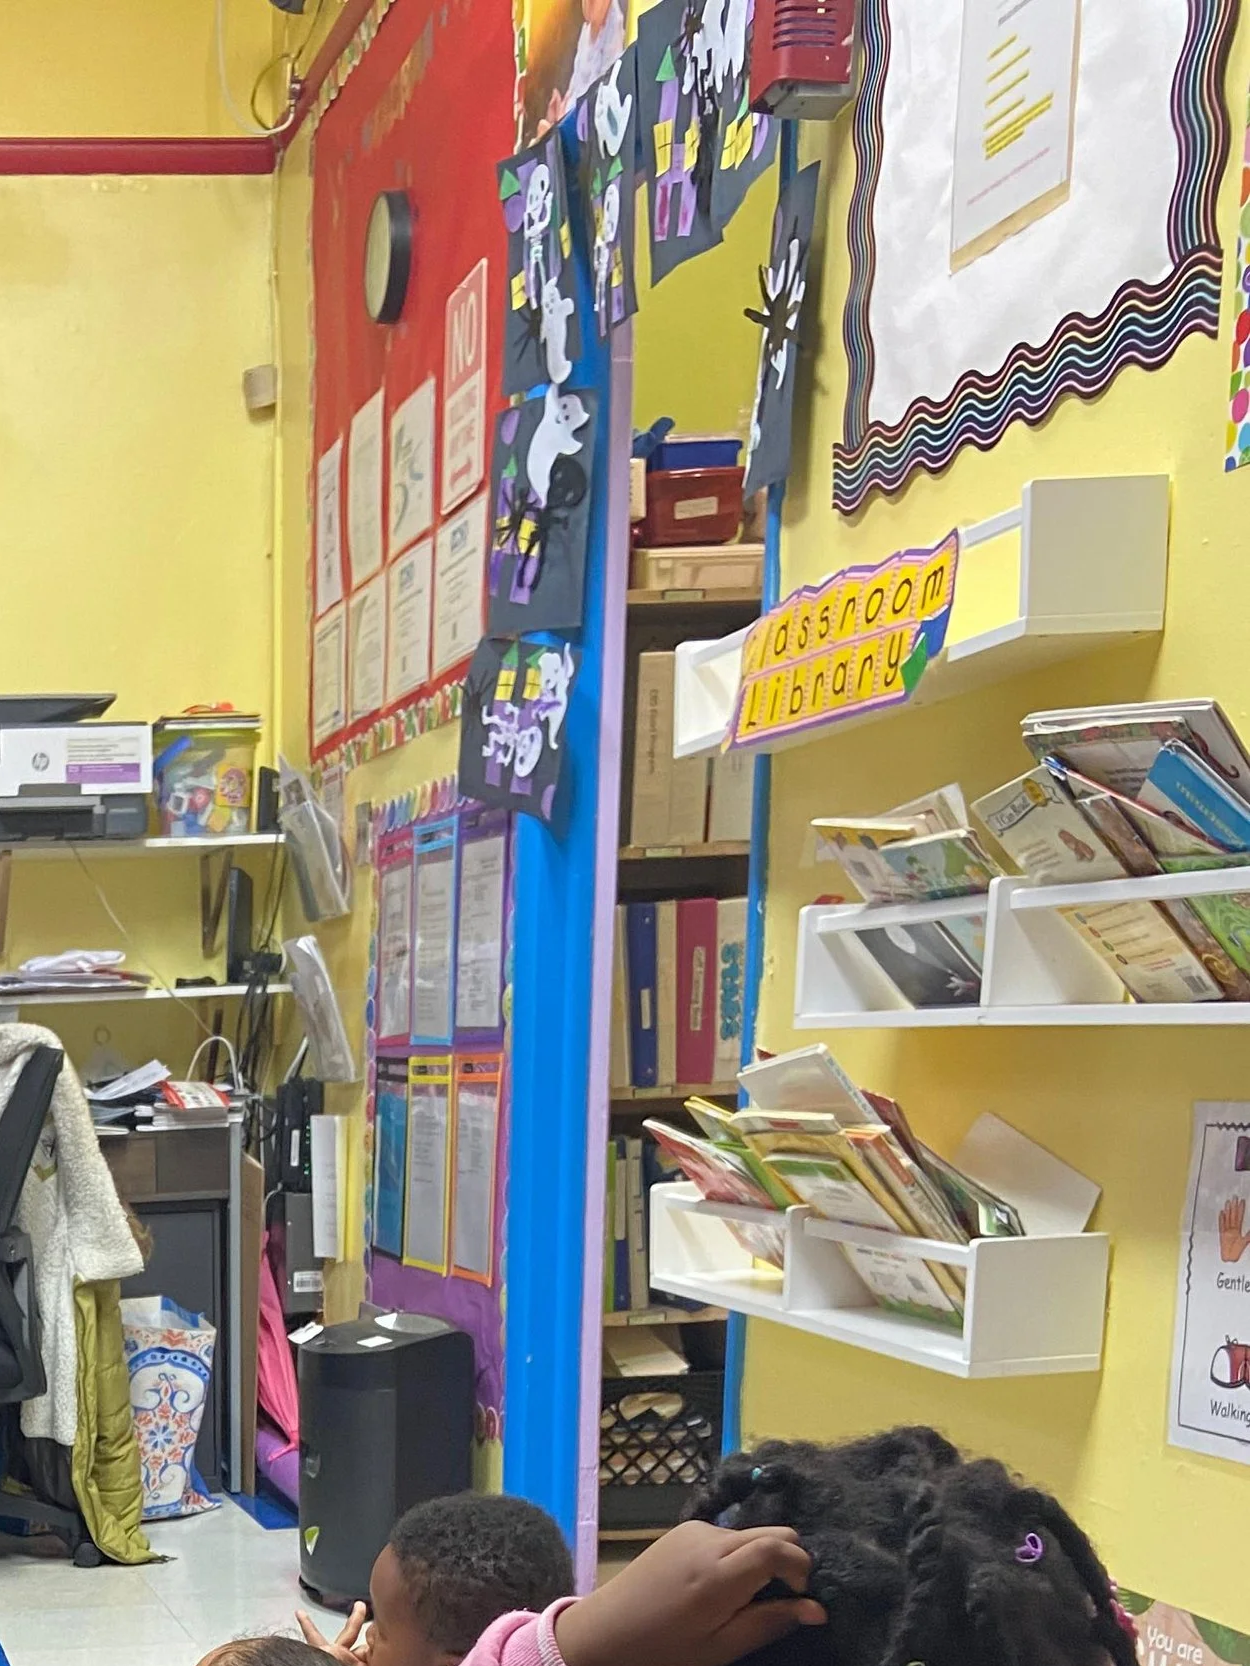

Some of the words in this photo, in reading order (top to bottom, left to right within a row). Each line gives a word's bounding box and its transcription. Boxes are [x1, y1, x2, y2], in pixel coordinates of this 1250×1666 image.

[452, 290, 477, 382] NO
[751, 565, 944, 669] lassroom
[1217, 1271, 1250, 1293] Gentle
[1177, 1642, 1203, 1665] are
